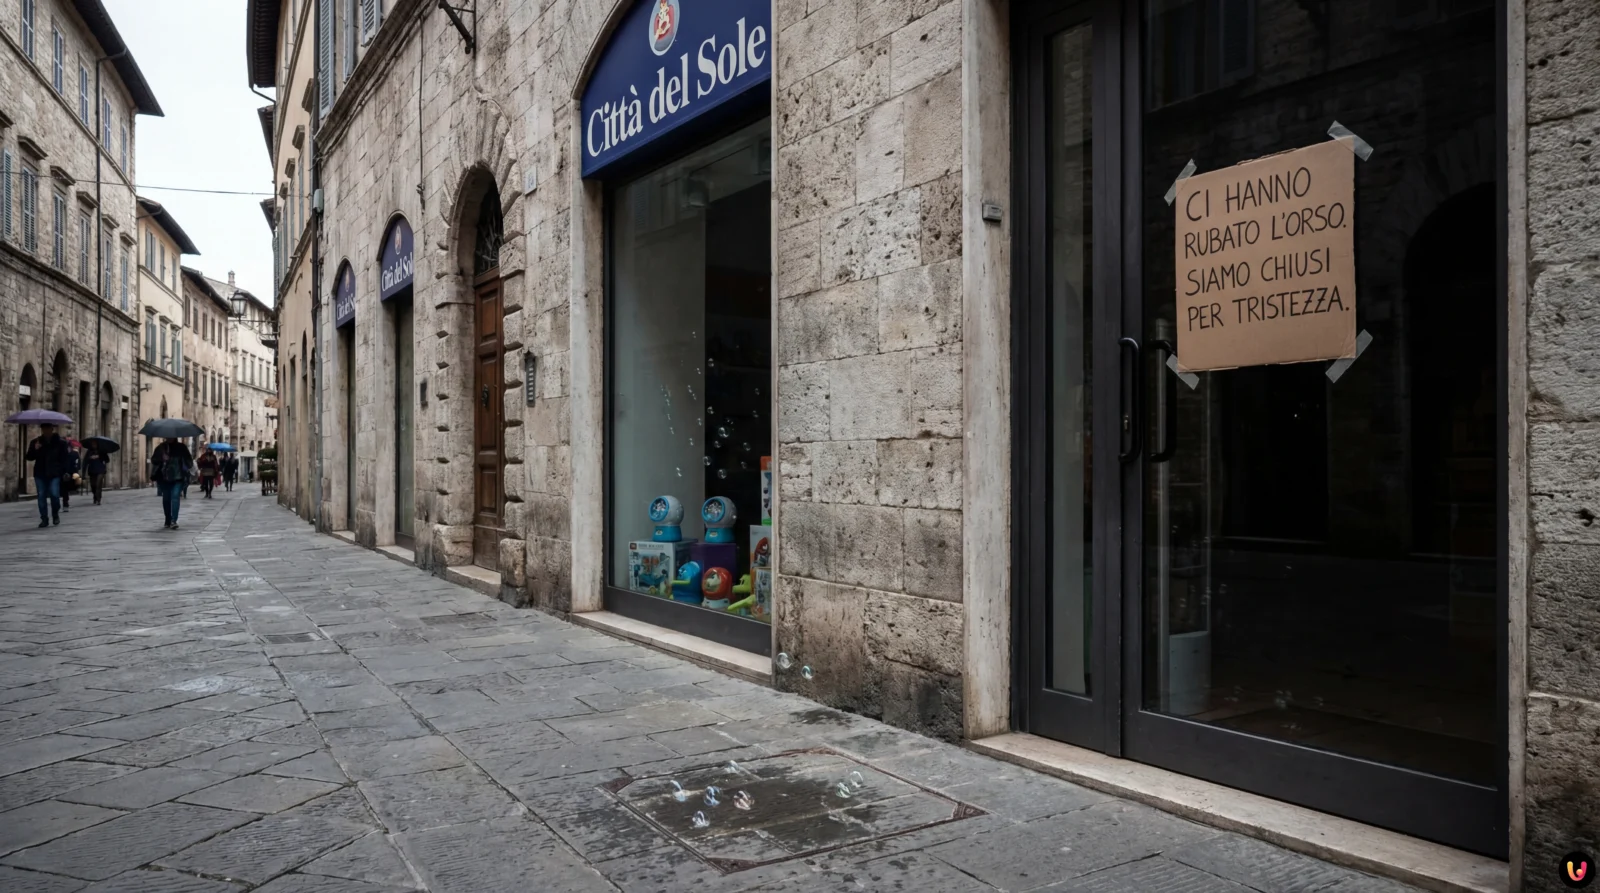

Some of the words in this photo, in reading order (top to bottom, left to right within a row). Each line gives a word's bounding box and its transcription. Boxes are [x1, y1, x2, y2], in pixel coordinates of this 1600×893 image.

[587, 84, 644, 157] Città
[649, 52, 690, 124] del
[697, 17, 766, 100] Sole
[1186, 188, 1210, 222] CI
[1225, 166, 1312, 214] HANNO
[1184, 219, 1260, 259] RUBATO
[1271, 201, 1347, 241] L'ORSO.
[403, 252, 413, 278] Sol
[1185, 261, 1251, 296] SIAMO
[1260, 246, 1331, 282] CHIUSI
[1187, 302, 1225, 332] PER
[1232, 284, 1350, 324] TRISTEZZA.
